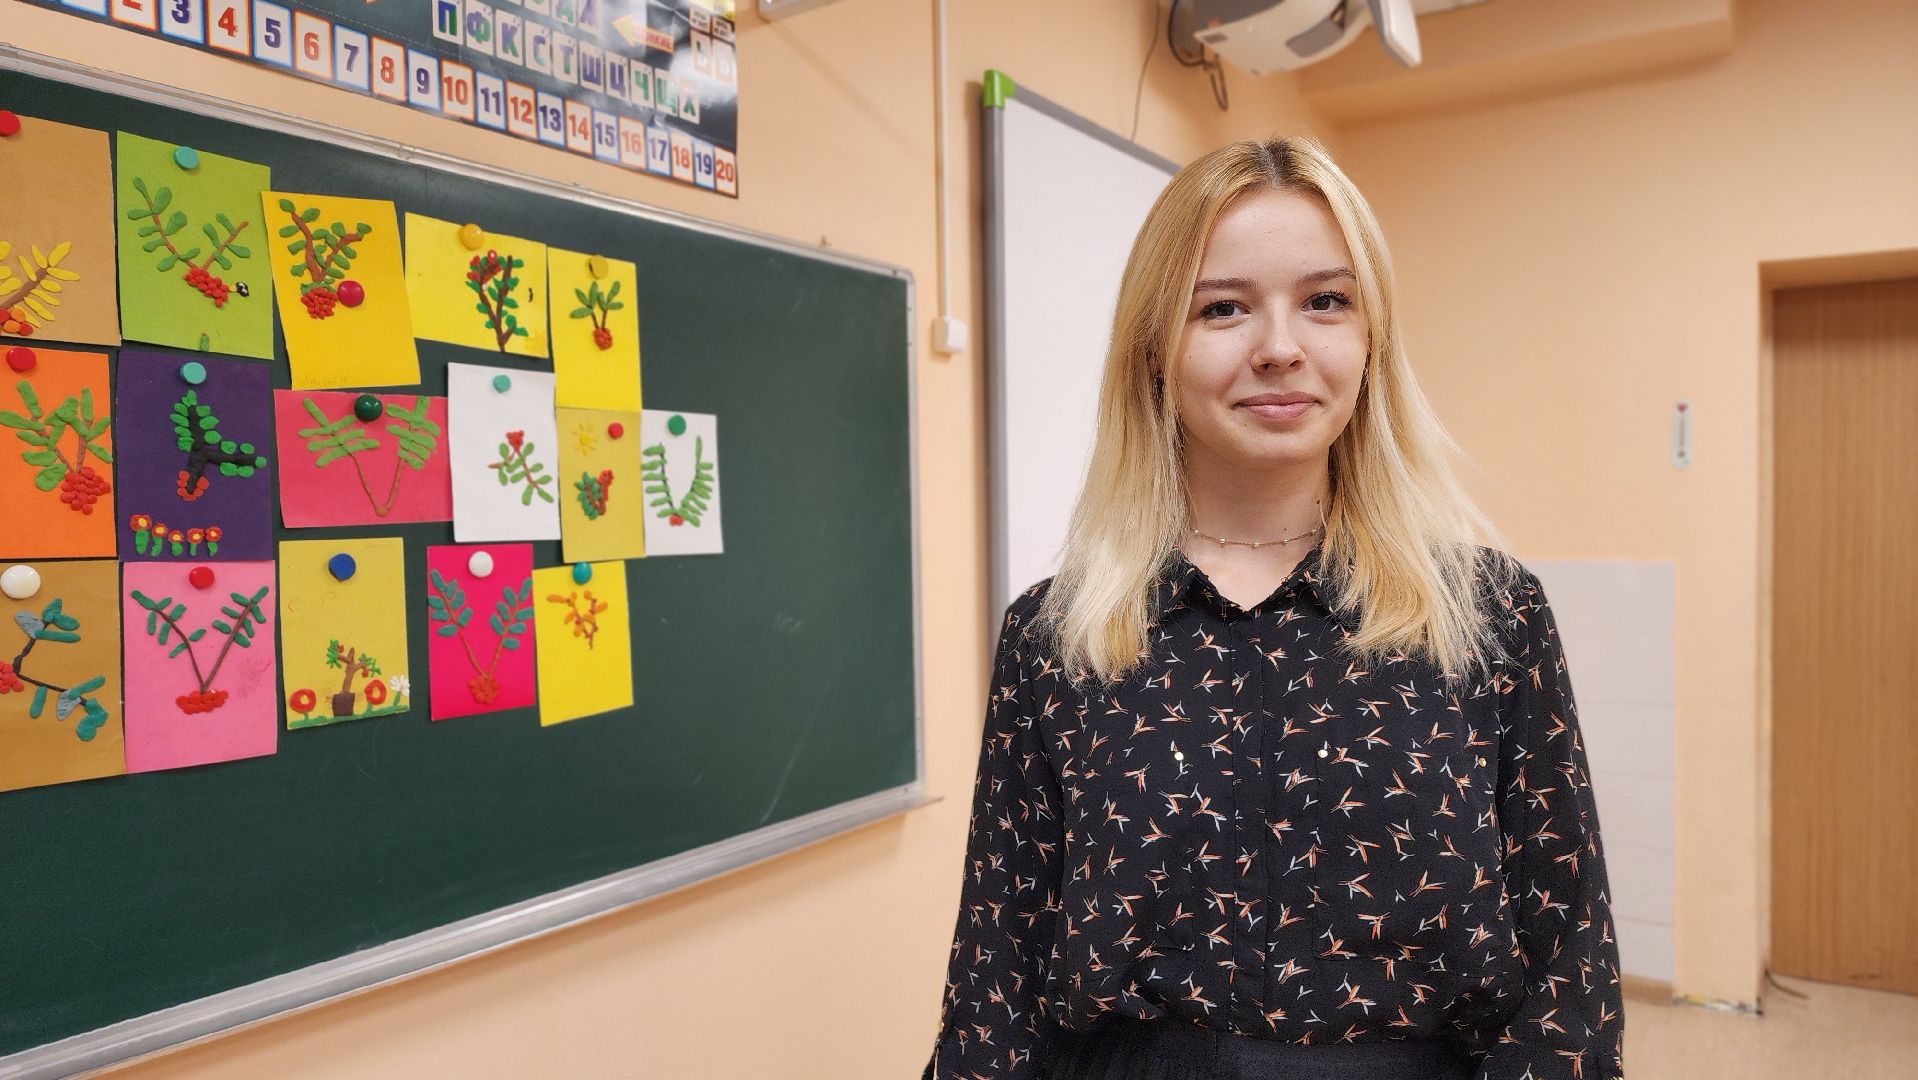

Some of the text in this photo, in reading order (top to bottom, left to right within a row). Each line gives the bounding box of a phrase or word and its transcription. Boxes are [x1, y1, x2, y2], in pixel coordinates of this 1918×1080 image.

[172, 0, 190, 24] 3
[218, 7, 238, 37] 4
[265, 18, 281, 48] 5
[304, 32, 320, 61] 6
[344, 43, 359, 72] 7
[380, 56, 394, 83] 8
[416, 68, 430, 94] 9
[444, 76, 468, 105] 10
[480, 87, 501, 116] 11
[511, 96, 533, 124] 12
[539, 105, 562, 132] 13
[569, 114, 589, 140] 14
[596, 123, 615, 147] 15
[622, 130, 641, 155] 16
[650, 138, 667, 161] 17
[673, 145, 690, 169] 18
[695, 152, 712, 176] 19
[716, 159, 734, 183] 20
[438, 1, 457, 36] П
[467, 11, 491, 43] Ф
[502, 22, 518, 57] К
[533, 35, 546, 66] С
[560, 45, 574, 75] Т
[582, 52, 602, 86] Ш
[610, 61, 626, 97] Ц
[635, 70, 649, 101] Ч
